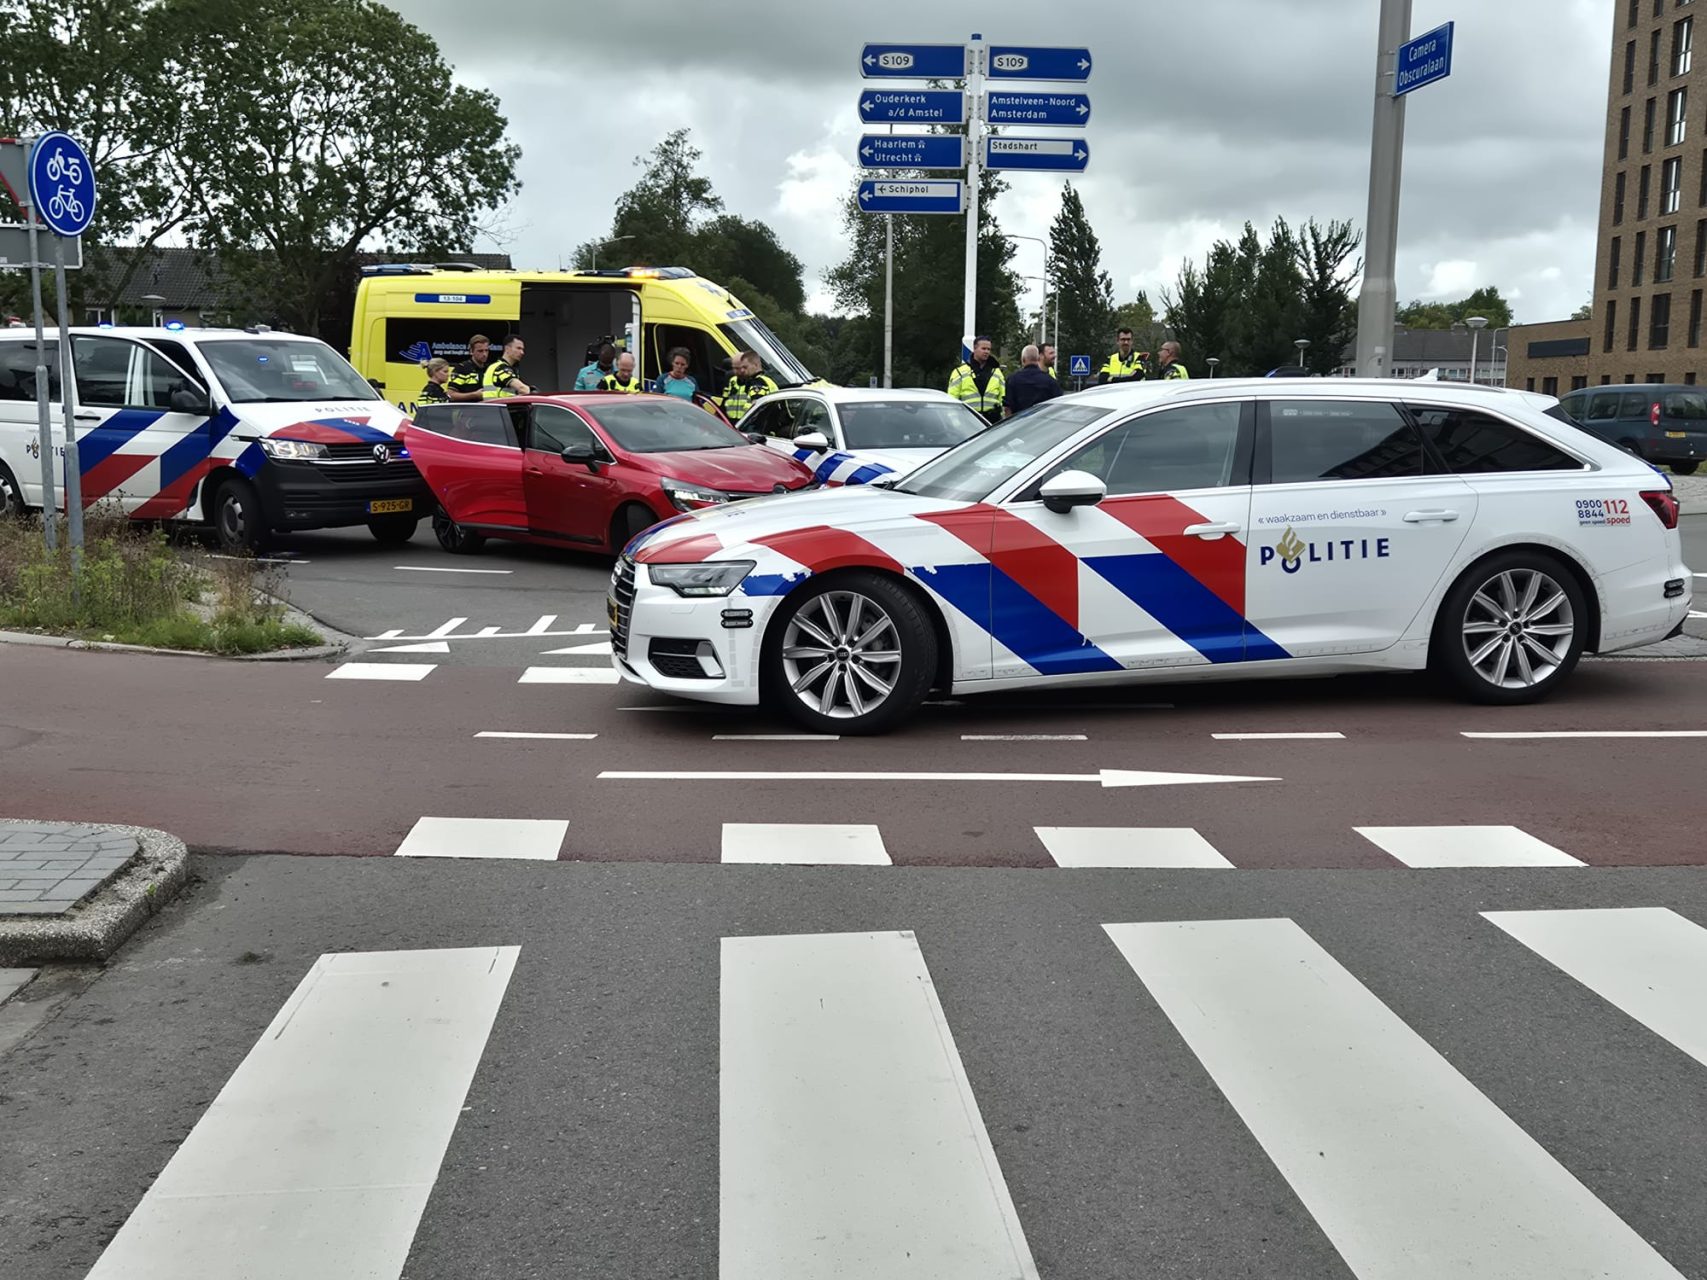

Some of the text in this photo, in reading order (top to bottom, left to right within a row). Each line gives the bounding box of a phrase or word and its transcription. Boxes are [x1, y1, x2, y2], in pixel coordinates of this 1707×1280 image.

[1408, 39, 1437, 62] Camera
[1399, 56, 1444, 87] Obscuralaan
[875, 94, 926, 103] Ouderkerk
[888, 107, 943, 117] a/d Amstel
[991, 108, 1047, 119] Amsterdam
[874, 139, 916, 149] Haarlem
[992, 141, 1038, 151] Stadshart
[874, 153, 913, 162] Utrecht
[888, 184, 929, 195] Schiphol
[1575, 499, 1602, 509] 0900
[1603, 499, 1629, 514] 112
[1265, 514, 1316, 524] waakzaam
[1317, 513, 1329, 521] en
[1330, 508, 1379, 520] dienstbaar
[1578, 509, 1605, 518] 8844
[1606, 515, 1631, 526] spoed
[1260, 537, 1390, 574] POLITIE
